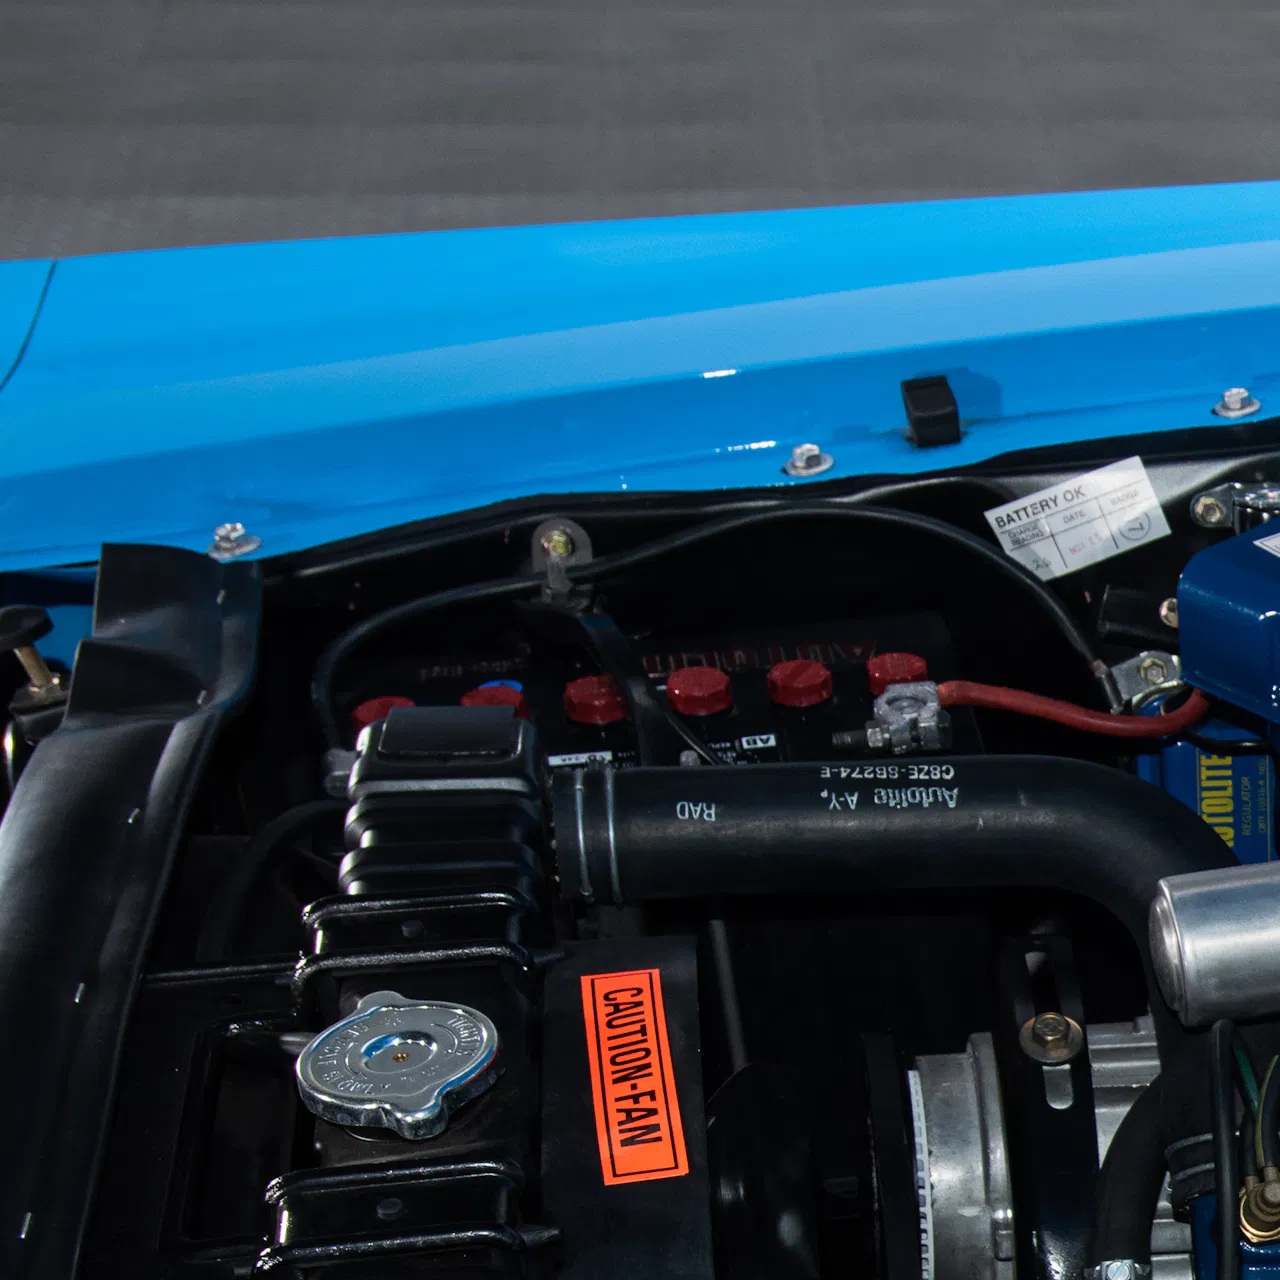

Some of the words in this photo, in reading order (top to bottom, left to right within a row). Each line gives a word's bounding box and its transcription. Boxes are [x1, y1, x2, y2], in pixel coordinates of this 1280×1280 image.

[995, 496, 1059, 528] BATTERY
[1063, 485, 1086, 501] OK
[1063, 510, 1085, 524] DATE
[676, 801, 716, 822] RAD
[873, 787, 959, 809] Autolite
[1199, 754, 1235, 848] UTOLITE
[1240, 776, 1252, 836] REGULATOR
[602, 986, 663, 1149] CAUTION-FAN
